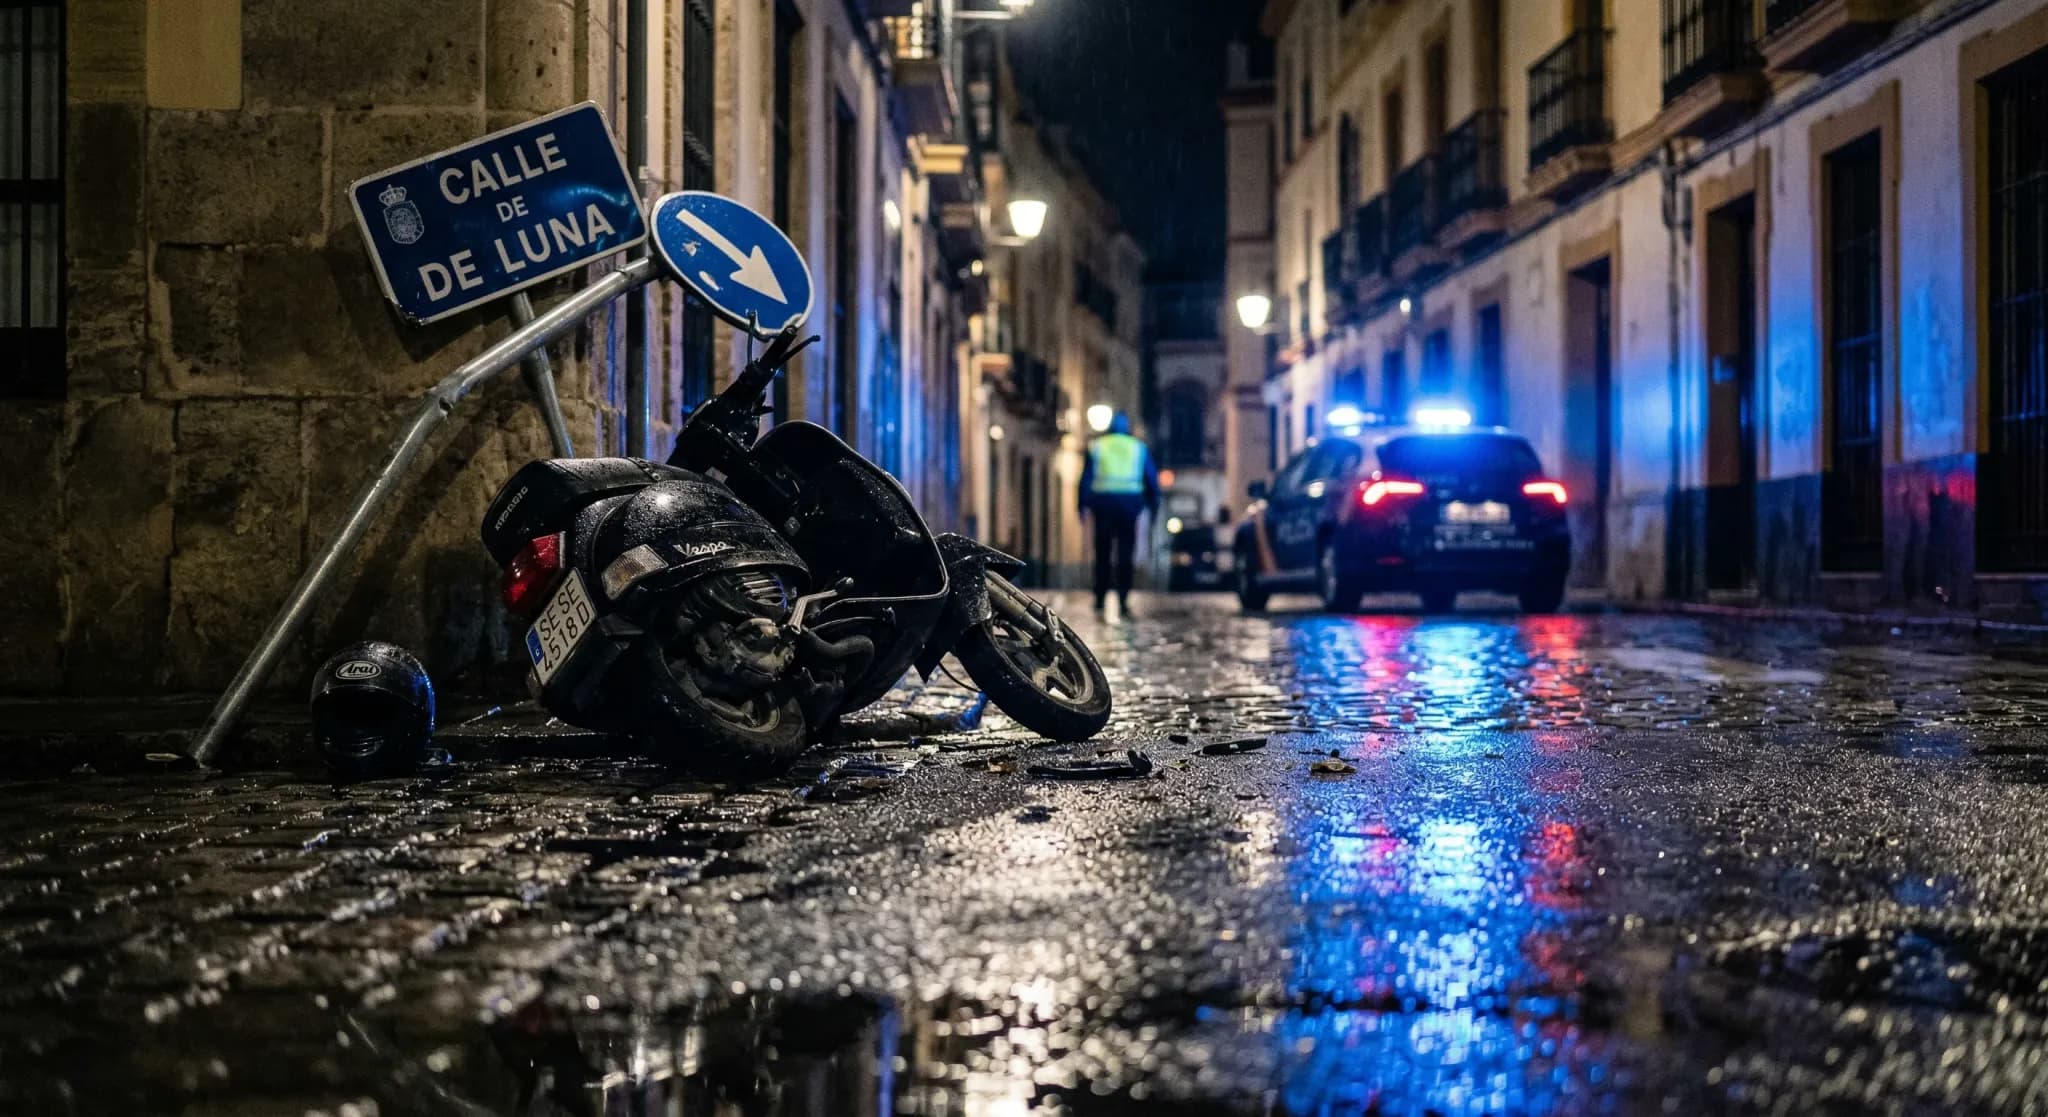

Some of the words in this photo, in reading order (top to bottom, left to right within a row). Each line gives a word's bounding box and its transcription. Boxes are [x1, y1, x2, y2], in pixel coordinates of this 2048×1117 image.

[440, 134, 567, 204] CALLE
[496, 196, 529, 223] DE
[419, 249, 484, 302] DE
[495, 203, 616, 274] LUNA
[340, 663, 376, 676] Arai
